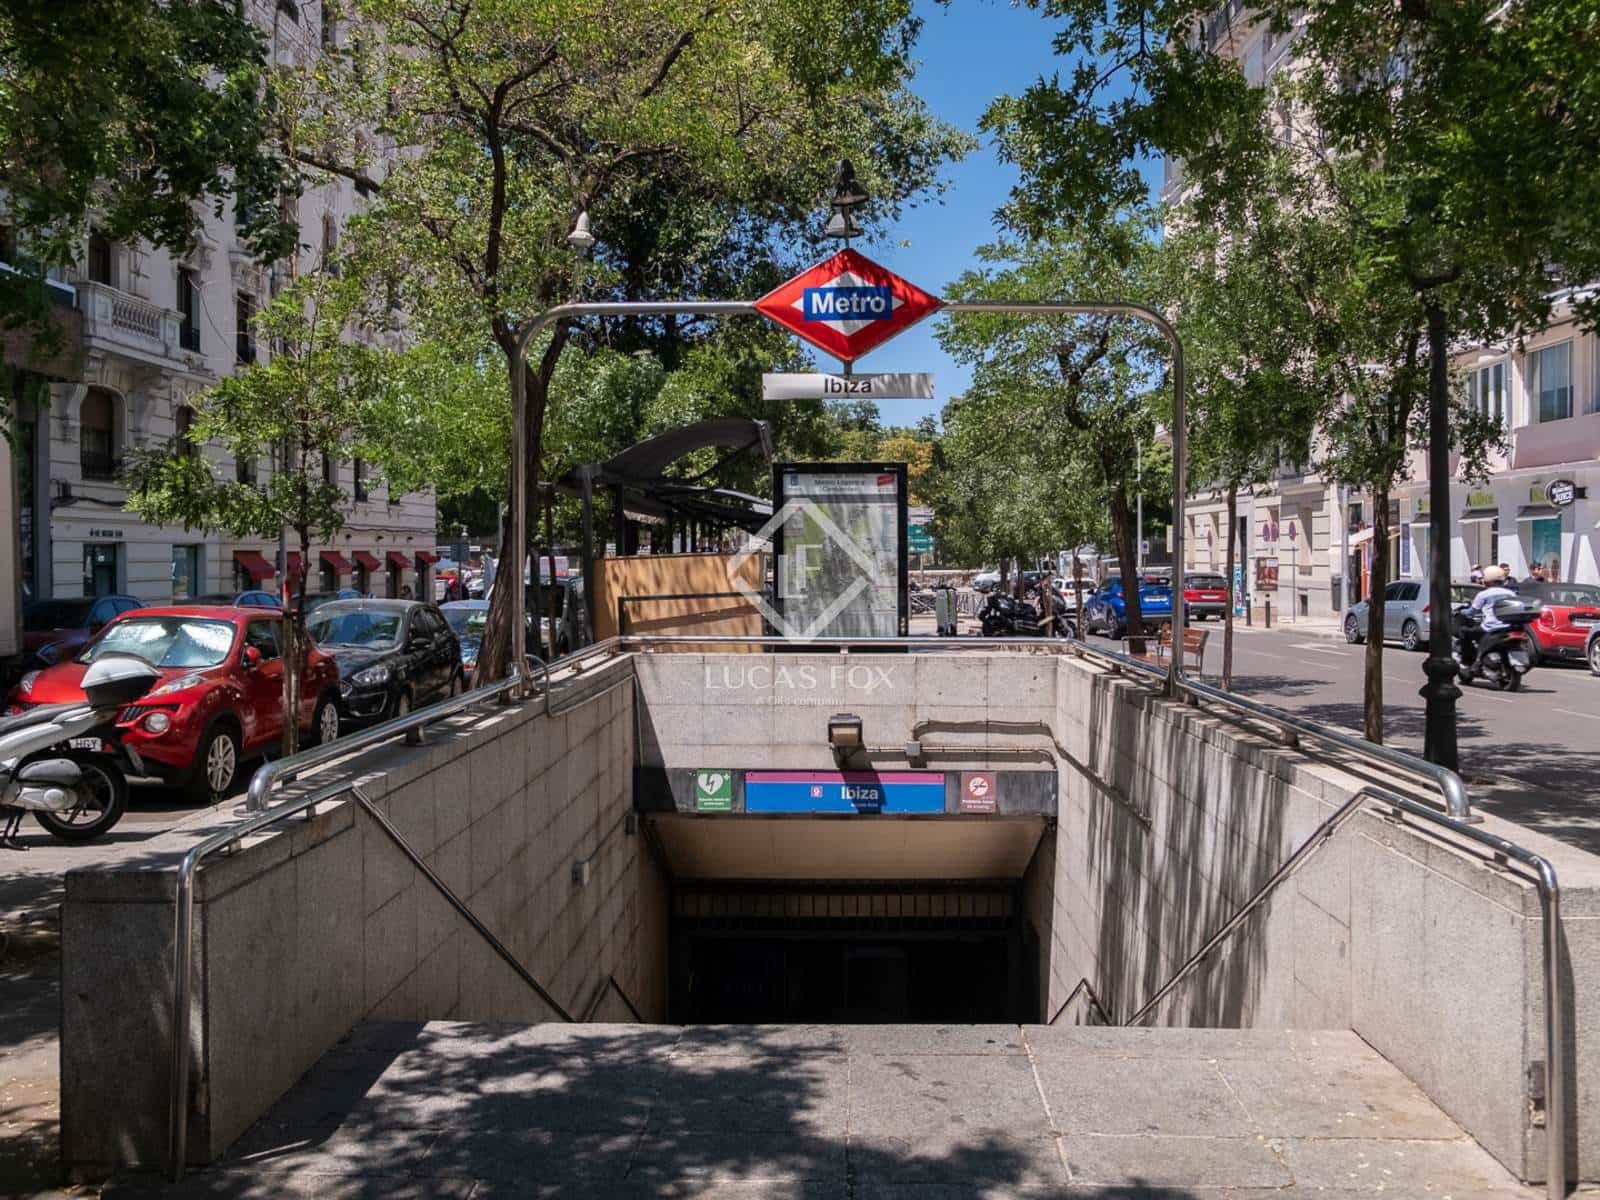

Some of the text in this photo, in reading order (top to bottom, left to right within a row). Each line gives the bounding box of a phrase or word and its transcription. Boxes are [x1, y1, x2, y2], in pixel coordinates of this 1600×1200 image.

[811, 292, 885, 314] Metro
[824, 378, 872, 394] Ibiza
[841, 785, 879, 800] Ibiza
